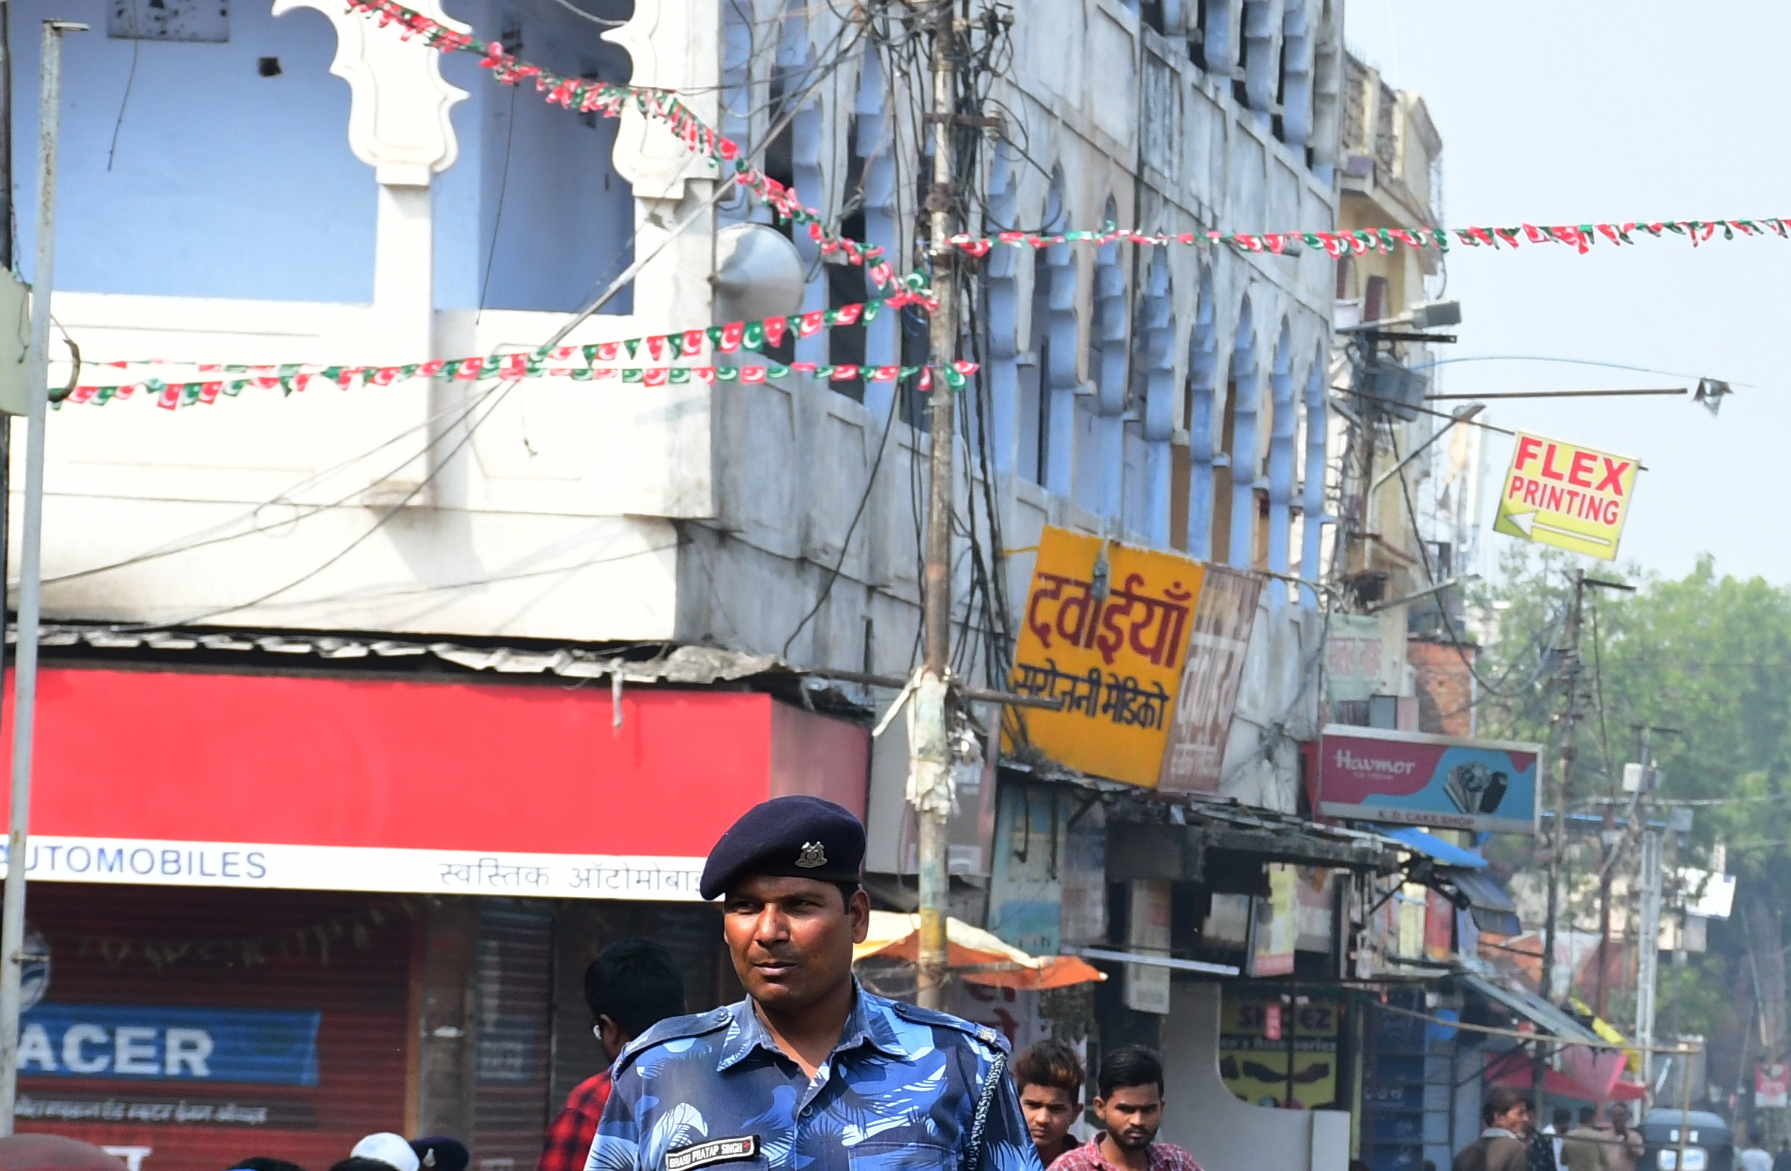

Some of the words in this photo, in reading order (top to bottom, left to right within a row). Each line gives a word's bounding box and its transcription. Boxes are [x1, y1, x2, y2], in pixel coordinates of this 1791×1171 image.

[1514, 435, 1630, 497] FLEX
[1508, 475, 1620, 526] PRINTING
[1333, 749, 1416, 776] Havmor
[17, 1023, 214, 1078] ACER
[669, 1153, 692, 1169] BHANU
[691, 1145, 720, 1163] PRATAP
[720, 1142, 743, 1155] SINGH
